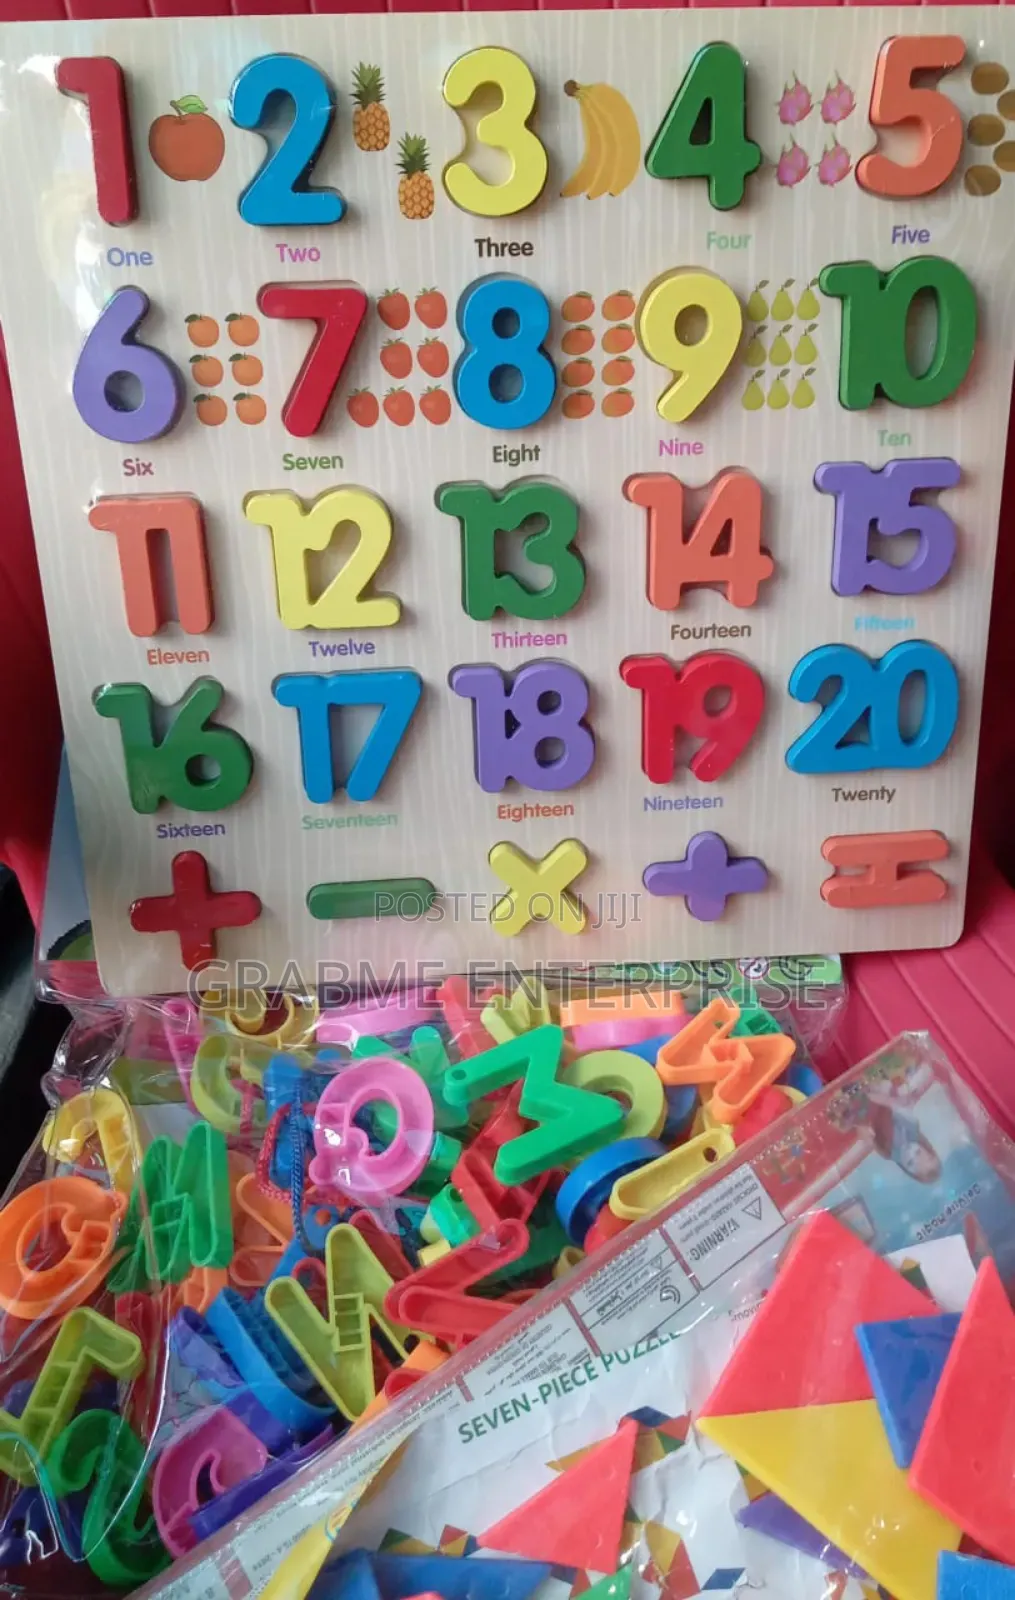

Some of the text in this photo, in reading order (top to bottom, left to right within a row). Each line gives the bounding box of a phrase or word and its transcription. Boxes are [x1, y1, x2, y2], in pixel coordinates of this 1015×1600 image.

[56, 56, 137, 226] 1
[230, 53, 347, 226] 2
[443, 46, 548, 217] 3
[645, 40, 762, 210] 4
[855, 34, 967, 197] 5
[107, 248, 153, 267] One
[276, 243, 321, 262] Two
[475, 239, 534, 258] Three
[706, 231, 751, 250] Four
[891, 225, 931, 244] Five
[72, 286, 186, 443] 6
[257, 280, 368, 438] 7
[453, 273, 556, 430] 8
[637, 266, 743, 423] 9
[819, 255, 977, 410] 10
[122, 459, 154, 476] Six
[282, 453, 344, 472] Seven
[492, 444, 541, 466] Eight
[659, 438, 704, 457] Nine
[878, 429, 911, 447] Ten
[243, 485, 401, 630] 12
[434, 476, 586, 621] 13
[622, 466, 774, 611] 14
[813, 457, 961, 597] 15
[88, 492, 214, 638] 11
[309, 639, 376, 657] Twelve
[491, 629, 568, 649] Thirteen
[670, 622, 752, 641] Fourteen
[854, 613, 916, 632] Fifteen
[147, 647, 210, 665] Eleven
[271, 666, 425, 804] 17
[449, 658, 595, 794] 18
[619, 651, 765, 784] 19
[784, 640, 960, 776] 20
[92, 675, 253, 815] 16
[301, 812, 399, 830] Seventeen
[496, 800, 575, 822] Eighteen
[643, 793, 724, 812] Nineteen
[831, 783, 897, 804] Twenty
[157, 822, 226, 839] Sixteen
[687, 1217, 741, 1261] WARNING:
[458, 1357, 599, 1444] SEVEN-PIECE
